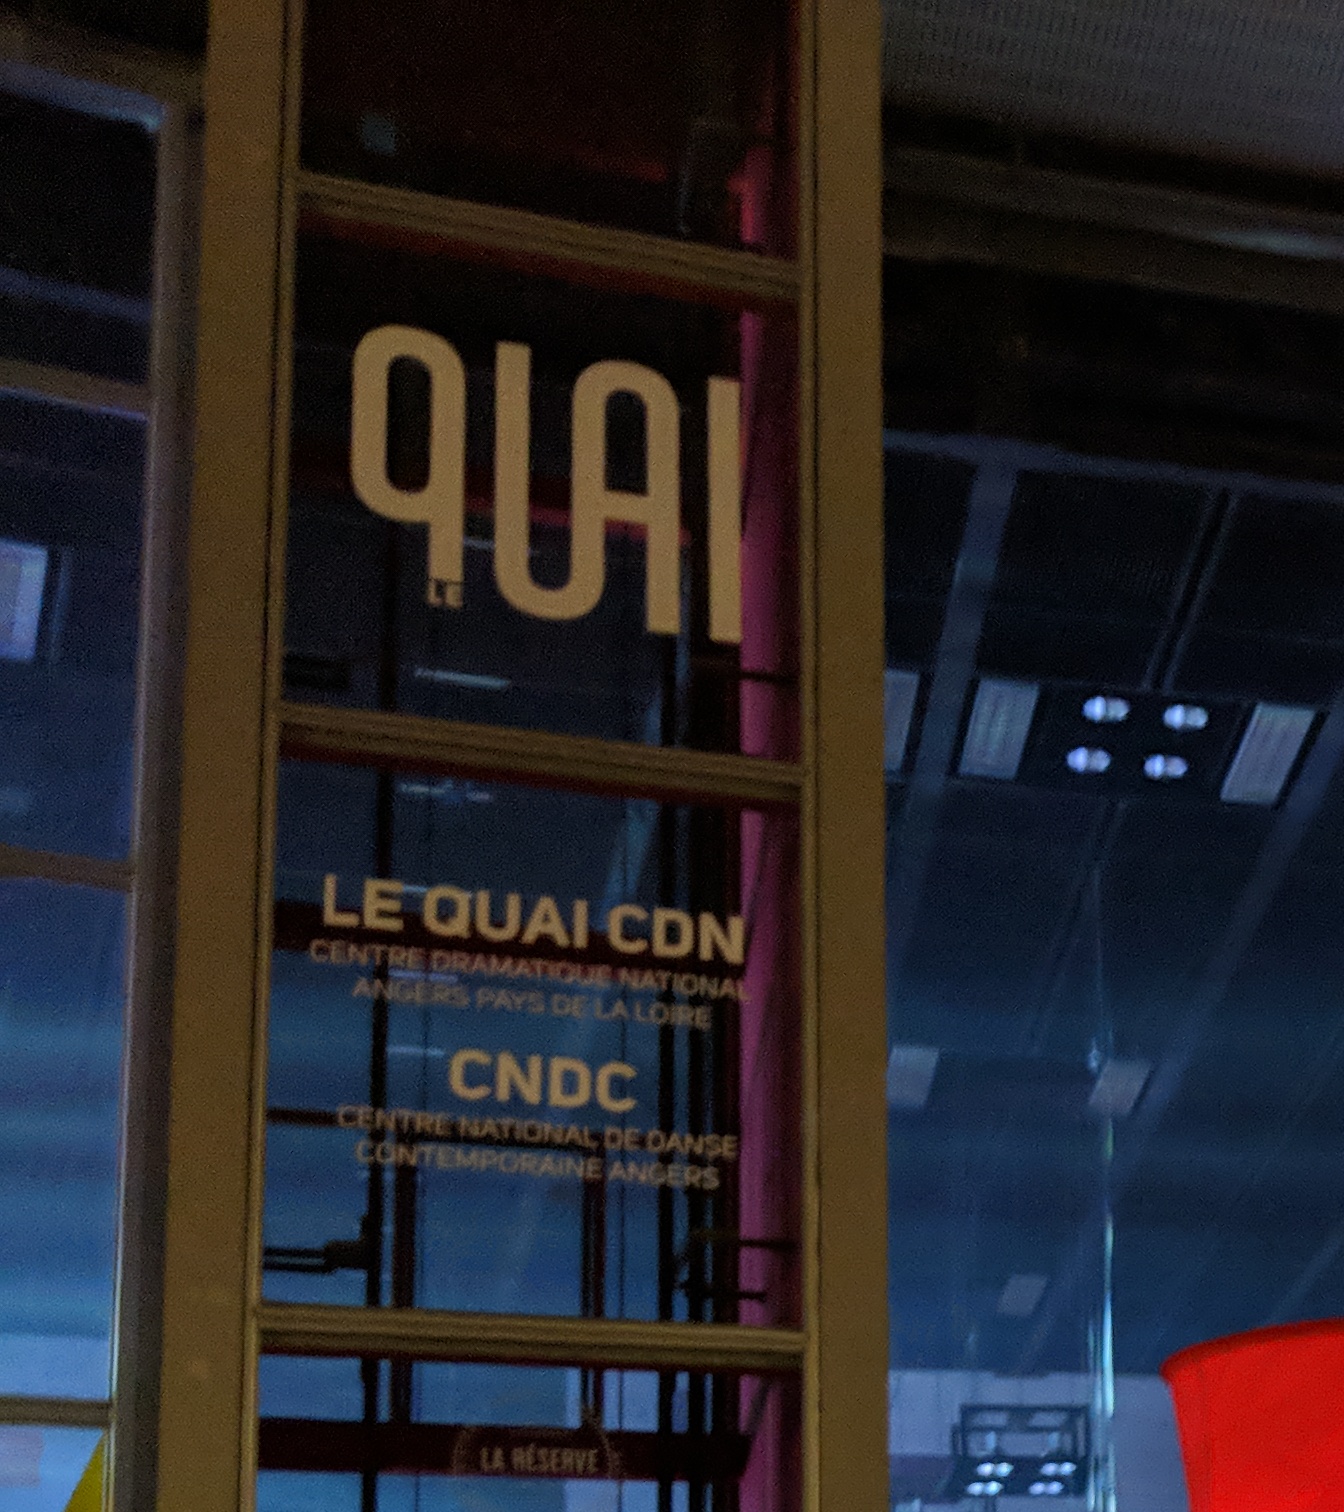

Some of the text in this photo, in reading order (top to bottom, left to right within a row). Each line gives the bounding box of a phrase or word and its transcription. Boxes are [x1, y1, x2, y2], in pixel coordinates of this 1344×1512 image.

[321, 874, 746, 966] LE QUAI CDN
[309, 938, 425, 969] CENTRE
[594, 997, 630, 1021] LA
[634, 1001, 713, 1031] LOIRE
[448, 1049, 638, 1114] CNDC
[336, 1104, 739, 1158] CENTRE NATIONAL DE DANSE
[355, 1141, 720, 1191] CONTEMPORAINE ANGERS
